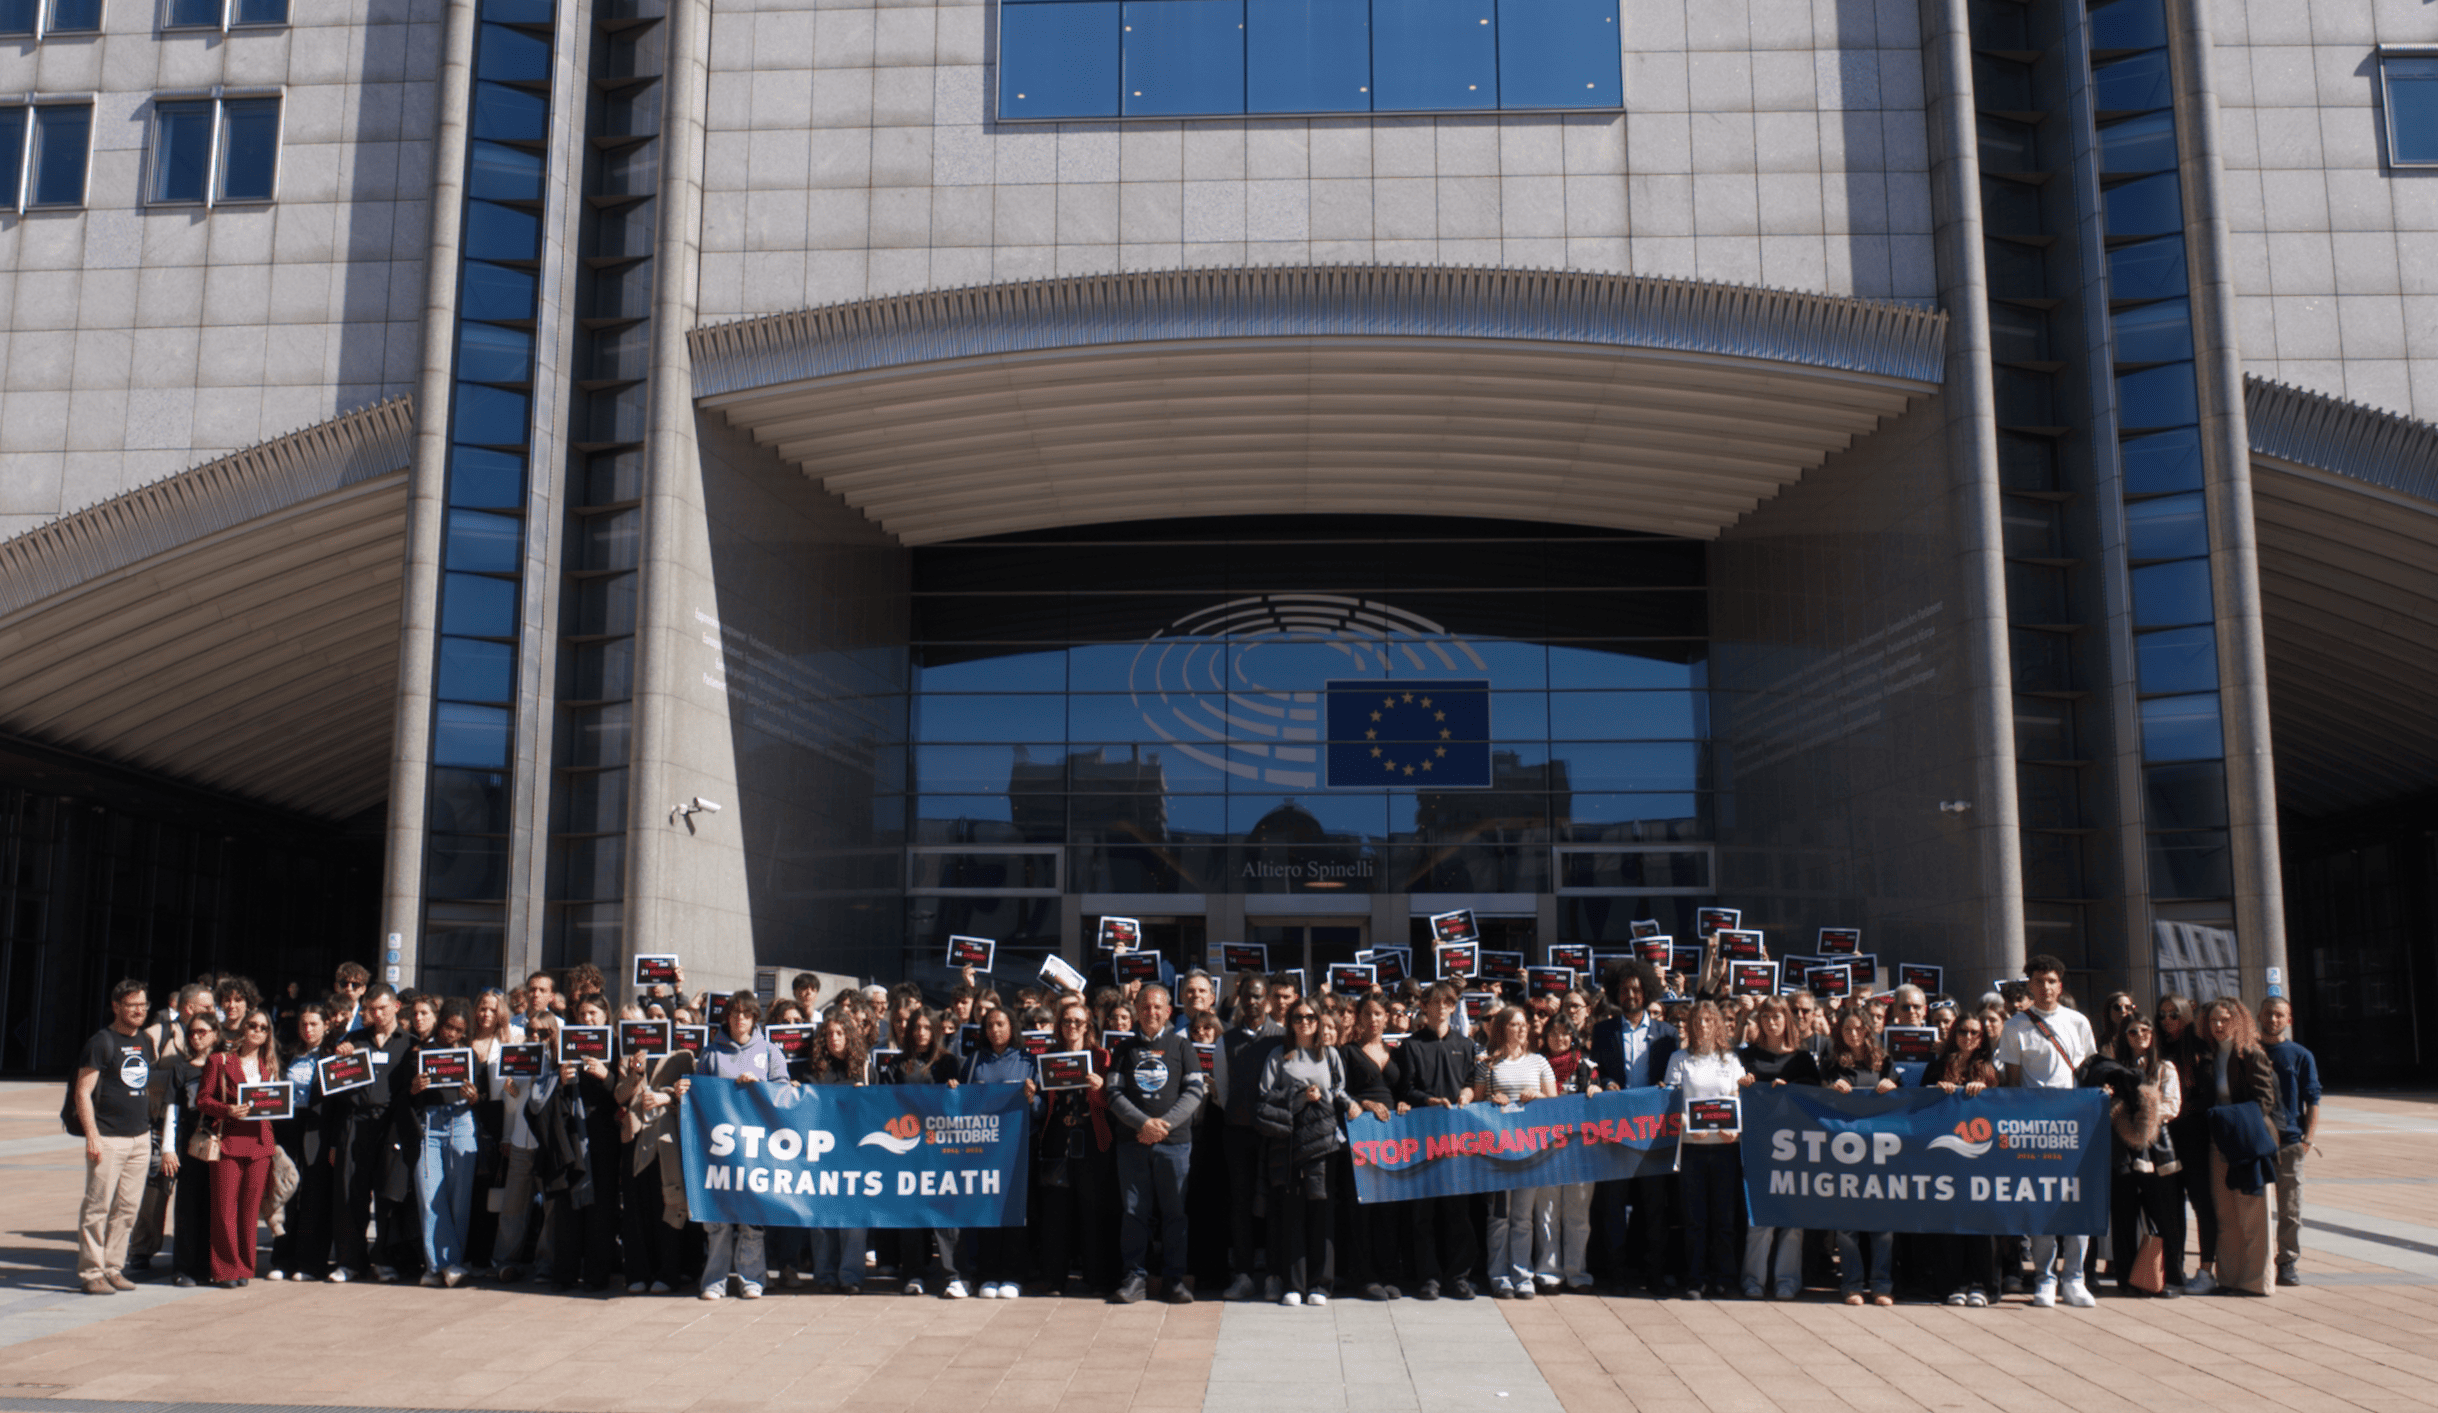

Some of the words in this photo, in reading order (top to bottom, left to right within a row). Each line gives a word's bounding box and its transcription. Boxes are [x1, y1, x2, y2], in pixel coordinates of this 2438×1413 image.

[1241, 861, 1302, 878] Altiero
[1307, 860, 1374, 881] Spinelli
[565, 1042, 576, 1051] 44
[427, 1066, 437, 1075] 14
[925, 1115, 1000, 1130] COMITATO
[1997, 1119, 2079, 1134] COMITATO
[709, 1123, 836, 1163] STOP
[1350, 1137, 1420, 1168] STOP
[1425, 1123, 1574, 1161] MIGRANTS'
[1581, 1113, 1682, 1146] DEATHS
[1771, 1128, 1902, 1165] STOP
[705, 1164, 884, 1197] MIGRANTS
[897, 1169, 1001, 1196] DEATH
[1769, 1170, 1956, 1201] MIGRANTS
[1970, 1176, 2082, 1202] DEATH
